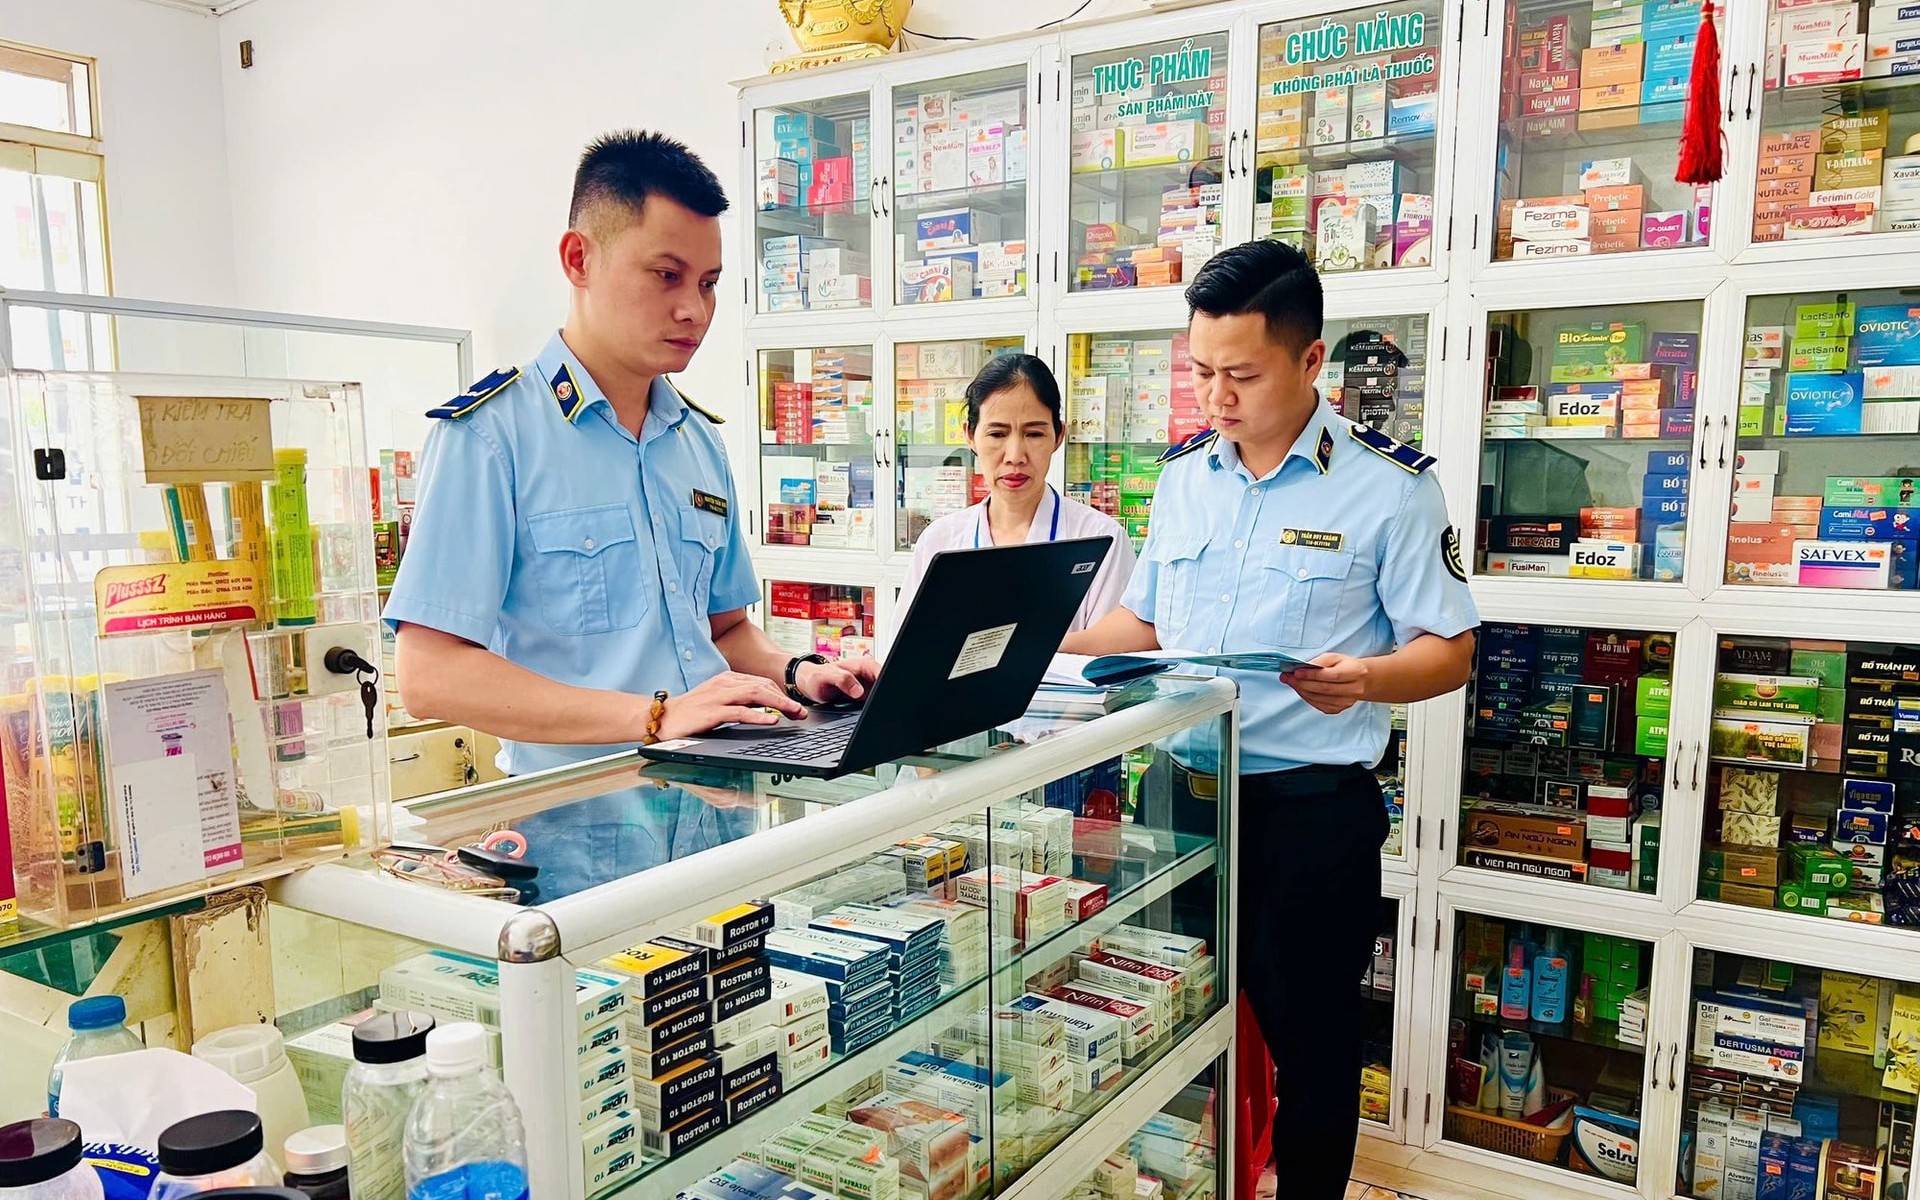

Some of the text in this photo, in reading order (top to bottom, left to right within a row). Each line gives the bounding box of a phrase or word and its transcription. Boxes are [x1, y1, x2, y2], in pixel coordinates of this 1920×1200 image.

[1286, 12, 1424, 65] CHỨC NĂNG
[1093, 38, 1211, 96] THỰC PHẨM
[1273, 72, 1320, 96] KHÔNG
[1362, 63, 1379, 83] LÀ
[1385, 51, 1434, 78] THUỐC
[1553, 95, 1570, 106] MM
[1767, 141, 1810, 152] NUTRA-C
[1760, 165, 1803, 175] NUT-C
[1525, 210, 1577, 221] Fezima
[1526, 244, 1578, 255] Fezima
[1859, 321, 1909, 333] OVIOTIC
[1791, 391, 1840, 400] OVIOTIC
[1560, 402, 1600, 415] Edoz
[1507, 537, 1560, 548] LIKECARE
[1576, 552, 1616, 566] Edoz
[1800, 548, 1865, 561] SAFVEX
[1511, 563, 1546, 572] FusiMan
[1547, 837, 1576, 847] NGON
[730, 916, 769, 938] ROSTOR 10
[652, 960, 700, 986] ROSTOR 10
[720, 966, 763, 989] ROSTOR 10
[652, 986, 699, 1014] ROSTOR 10
[725, 987, 766, 1011] ROSTOR 10
[659, 1012, 705, 1039] ROSTOR 10
[660, 1039, 707, 1066] ROSTOR 10
[1719, 1038, 1800, 1059] DERTUSMA FORT
[1719, 1050, 1733, 1059] Gel
[669, 1067, 715, 1095] ROSTOR 10
[730, 1062, 772, 1090] ROSTOR 10
[669, 1091, 715, 1119] ROSTOR 10
[737, 1084, 777, 1112] ROSTOR 10
[677, 1115, 721, 1146] ROSTOR 10
